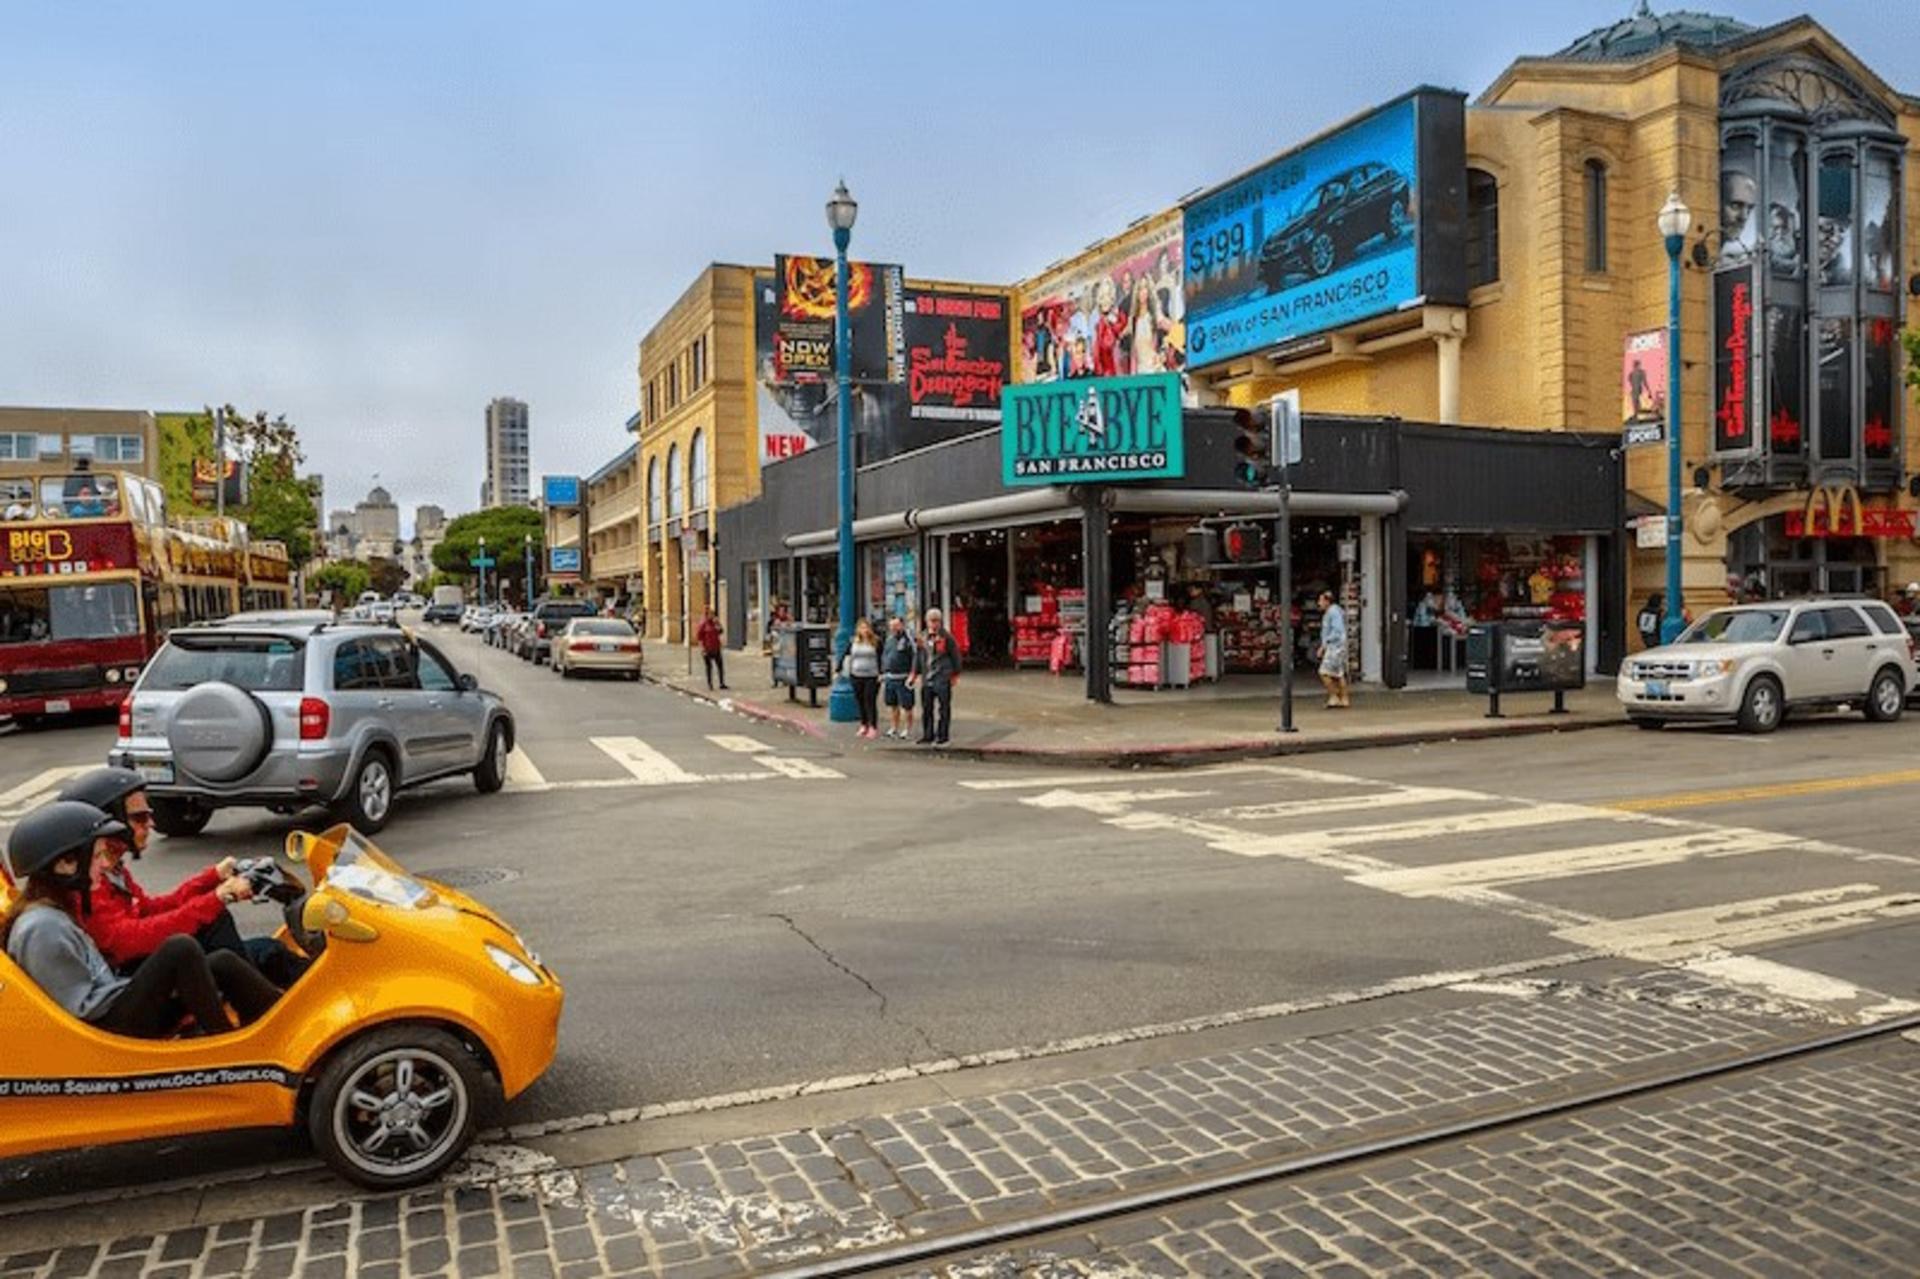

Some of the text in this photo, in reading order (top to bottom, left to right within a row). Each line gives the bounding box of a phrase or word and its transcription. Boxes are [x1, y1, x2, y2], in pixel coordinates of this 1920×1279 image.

[1190, 222, 1244, 275] $199
[1259, 303, 1291, 327] SAN
[1293, 269, 1390, 315] FRANCISCO
[780, 340, 830, 354] NOW
[780, 353, 829, 367] OPEN
[910, 372, 1003, 405] Dungeon
[1014, 385, 1168, 457] BYE BYE
[766, 434, 806, 458] NEW
[1016, 454, 1165, 474] SAN FRANCISCO
[9, 531, 44, 549] BIG
[13, 1081, 60, 1095] Union
[64, 1080, 120, 1096] Square
[134, 1069, 286, 1090] www.GoCarTours.com
